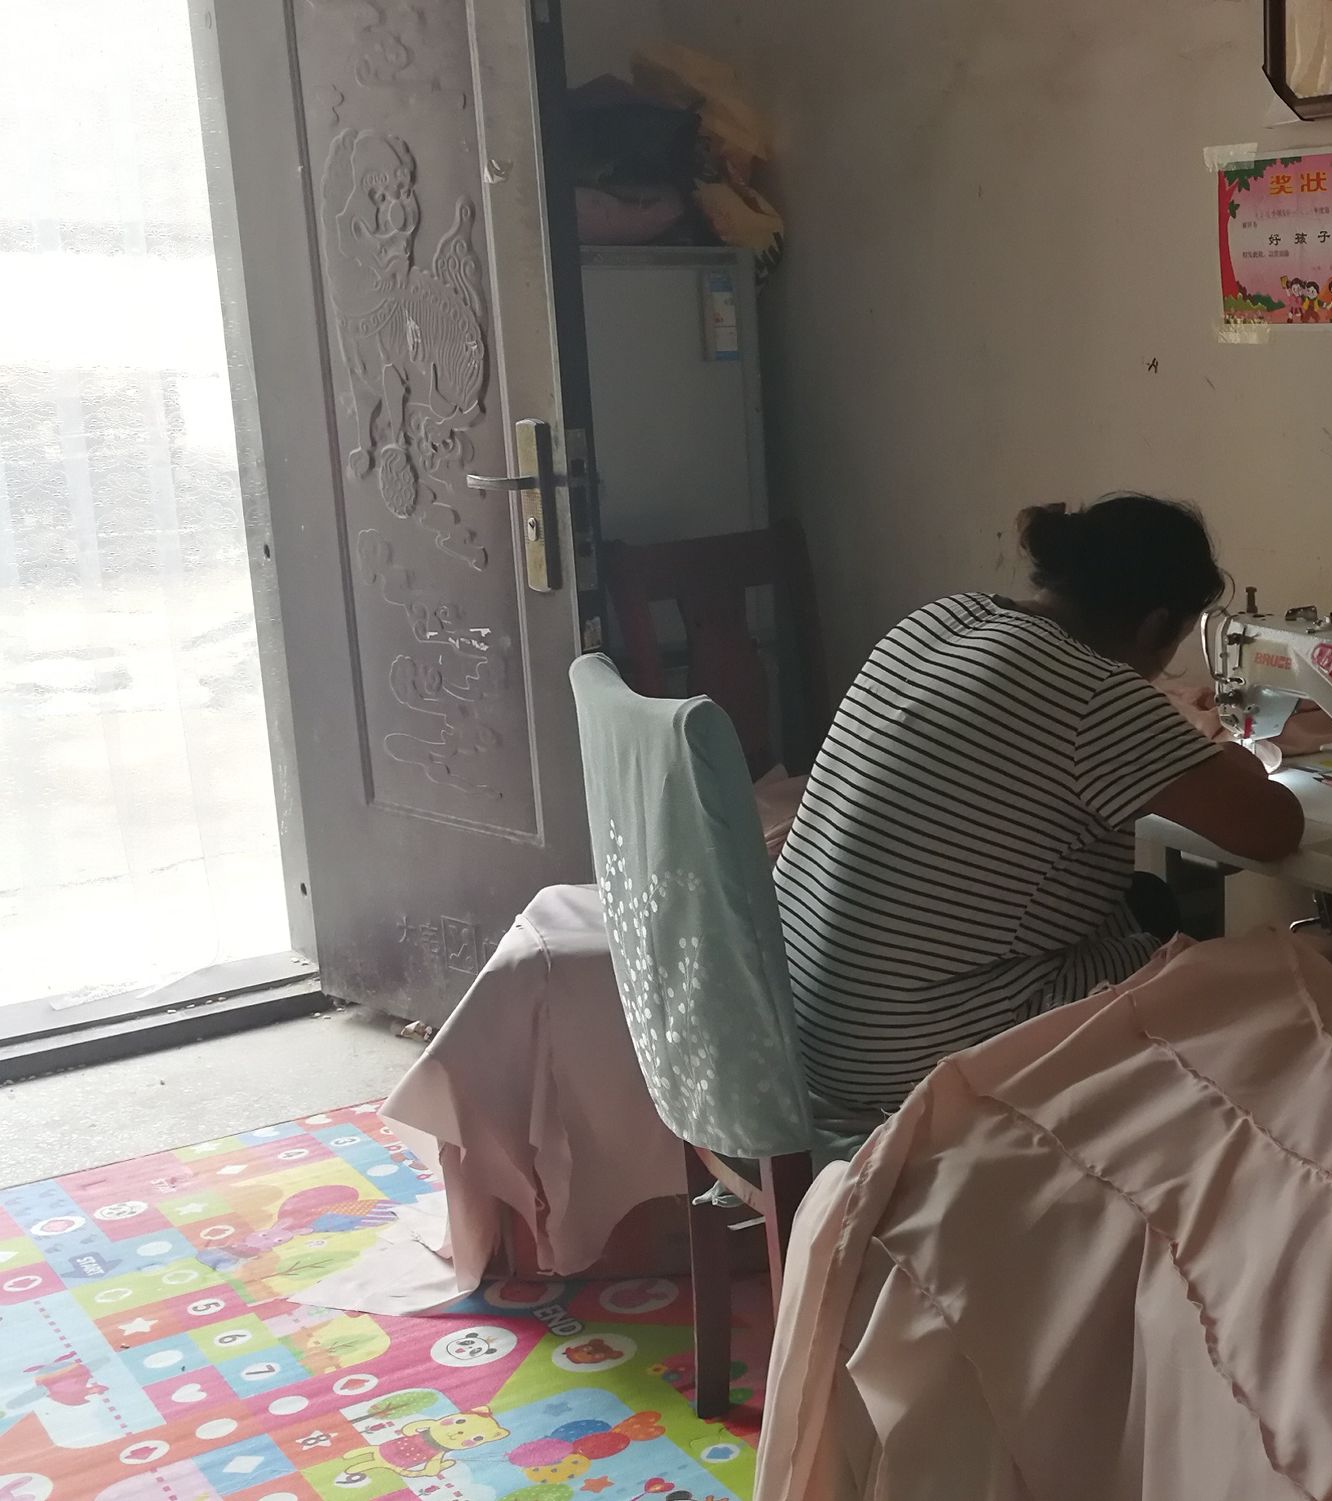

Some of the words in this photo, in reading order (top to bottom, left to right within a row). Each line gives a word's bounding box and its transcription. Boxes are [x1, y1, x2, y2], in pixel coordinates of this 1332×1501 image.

[1269, 172, 1328, 195] 奖状
[1268, 230, 1331, 246] 好孩子
[191, 1301, 222, 1313] 5
[532, 1304, 583, 1336] END
[244, 1364, 277, 1377] 7
[301, 1433, 332, 1447] 8
